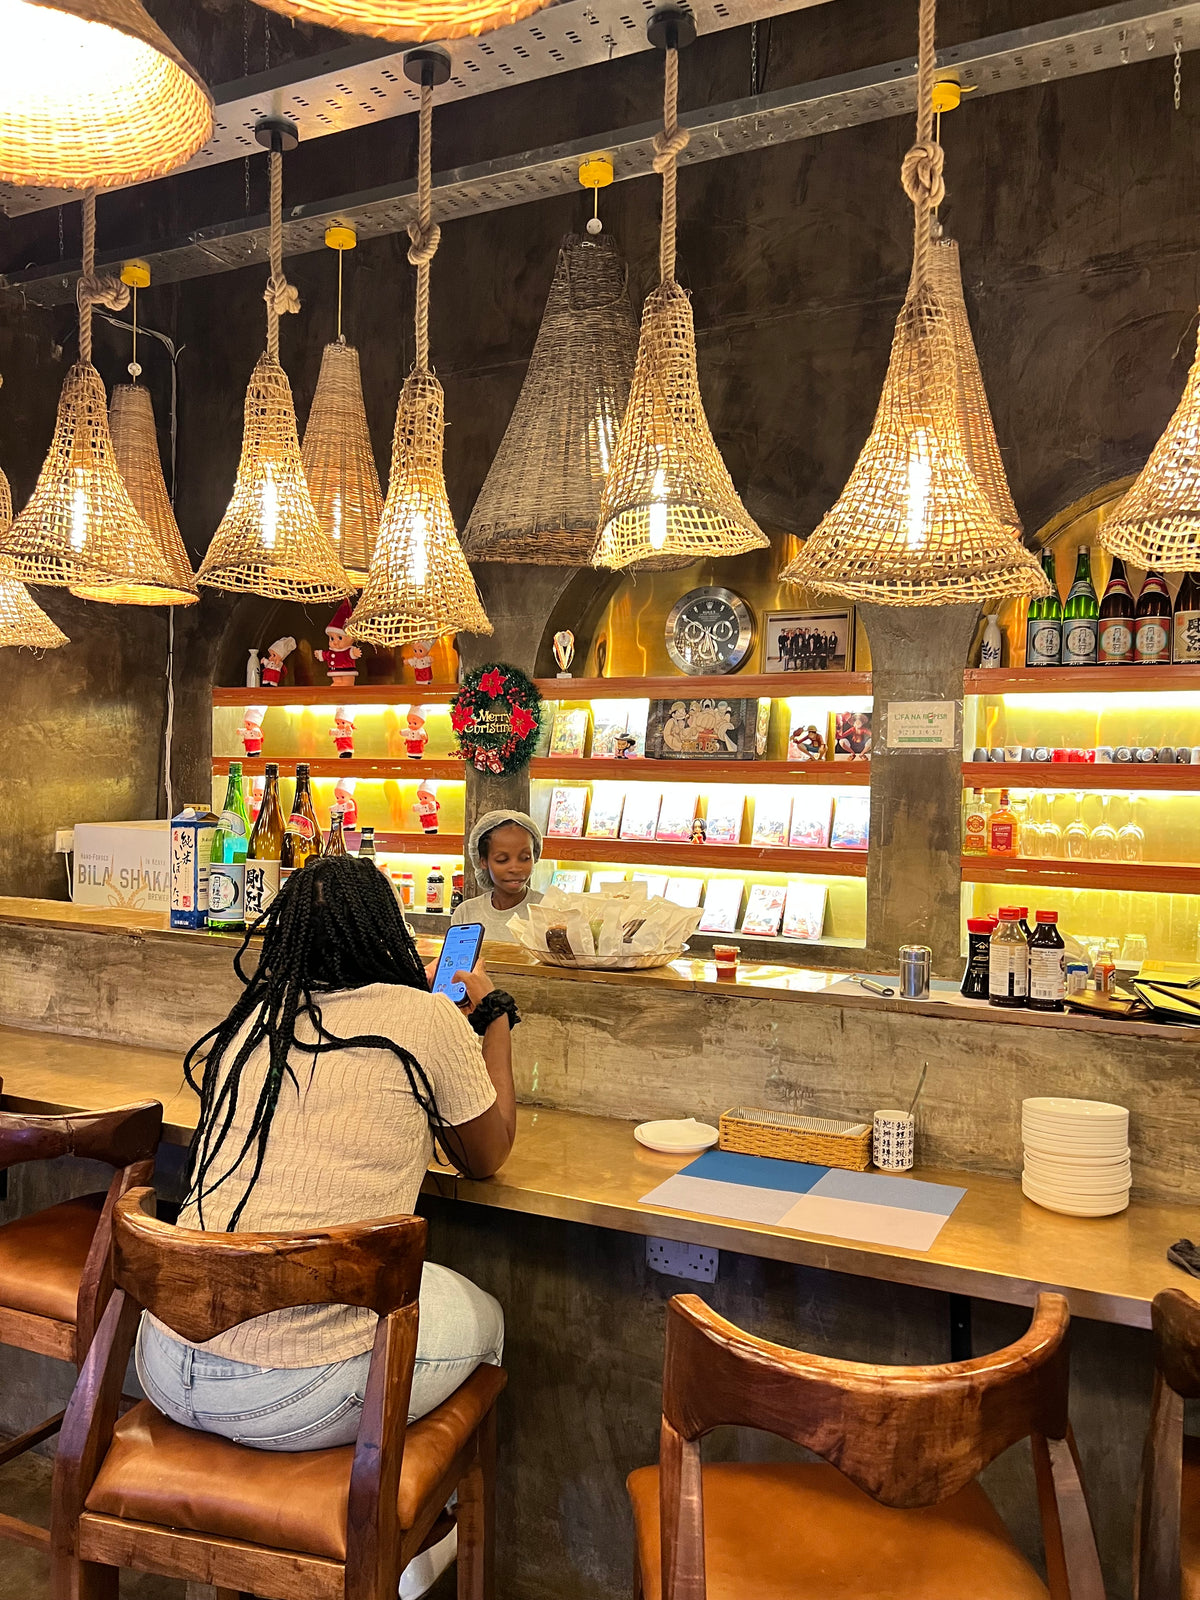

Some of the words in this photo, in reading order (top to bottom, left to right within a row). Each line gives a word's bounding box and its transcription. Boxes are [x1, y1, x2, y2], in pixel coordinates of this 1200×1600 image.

[476, 709, 512, 723] Merry
[464, 722, 514, 734] Christma
[180, 831, 194, 865] 純米
[172, 849, 181, 907] しぼりたて
[148, 893, 169, 902] BREWER
